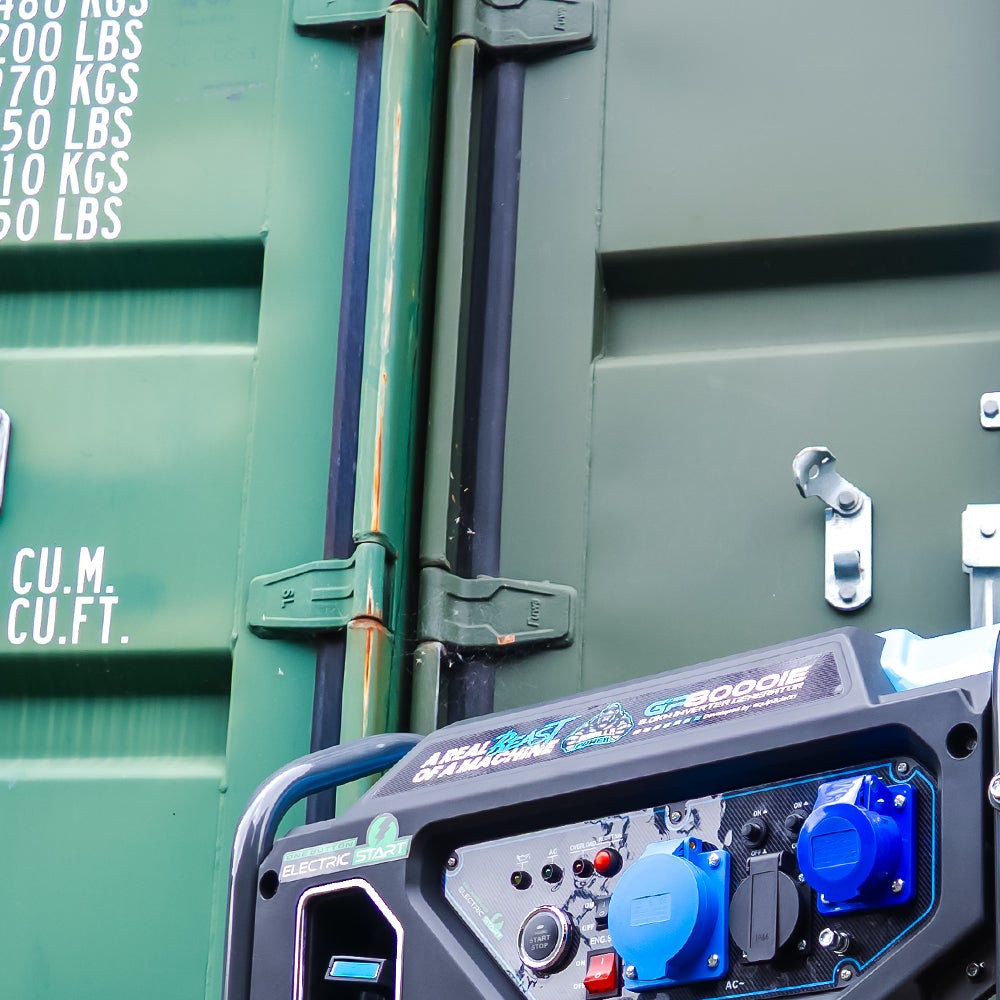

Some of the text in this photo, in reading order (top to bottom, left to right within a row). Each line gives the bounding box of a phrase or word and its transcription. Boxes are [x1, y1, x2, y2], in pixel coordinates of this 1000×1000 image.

[75, 19, 144, 62] LBS
[0, 62, 140, 107] 70 KGS
[0, 106, 133, 151] 50 LBS
[2, 150, 129, 196] 10 KGS
[53, 196, 123, 241] LBS
[12, 546, 115, 595] CU.M.
[7, 596, 129, 645] CU.FT.
[672, 698, 732, 718] INVERTER
[732, 681, 805, 704] GENERATOR
[412, 765, 445, 783] OF
[456, 738, 561, 774] MACHINE
[438, 740, 491, 765] REAL
[487, 714, 582, 756] BEAST
[753, 808, 762, 816] ON
[282, 841, 407, 878] ELECTRIC START
[530, 934, 551, 943] START
[531, 942, 549, 951] STOP
